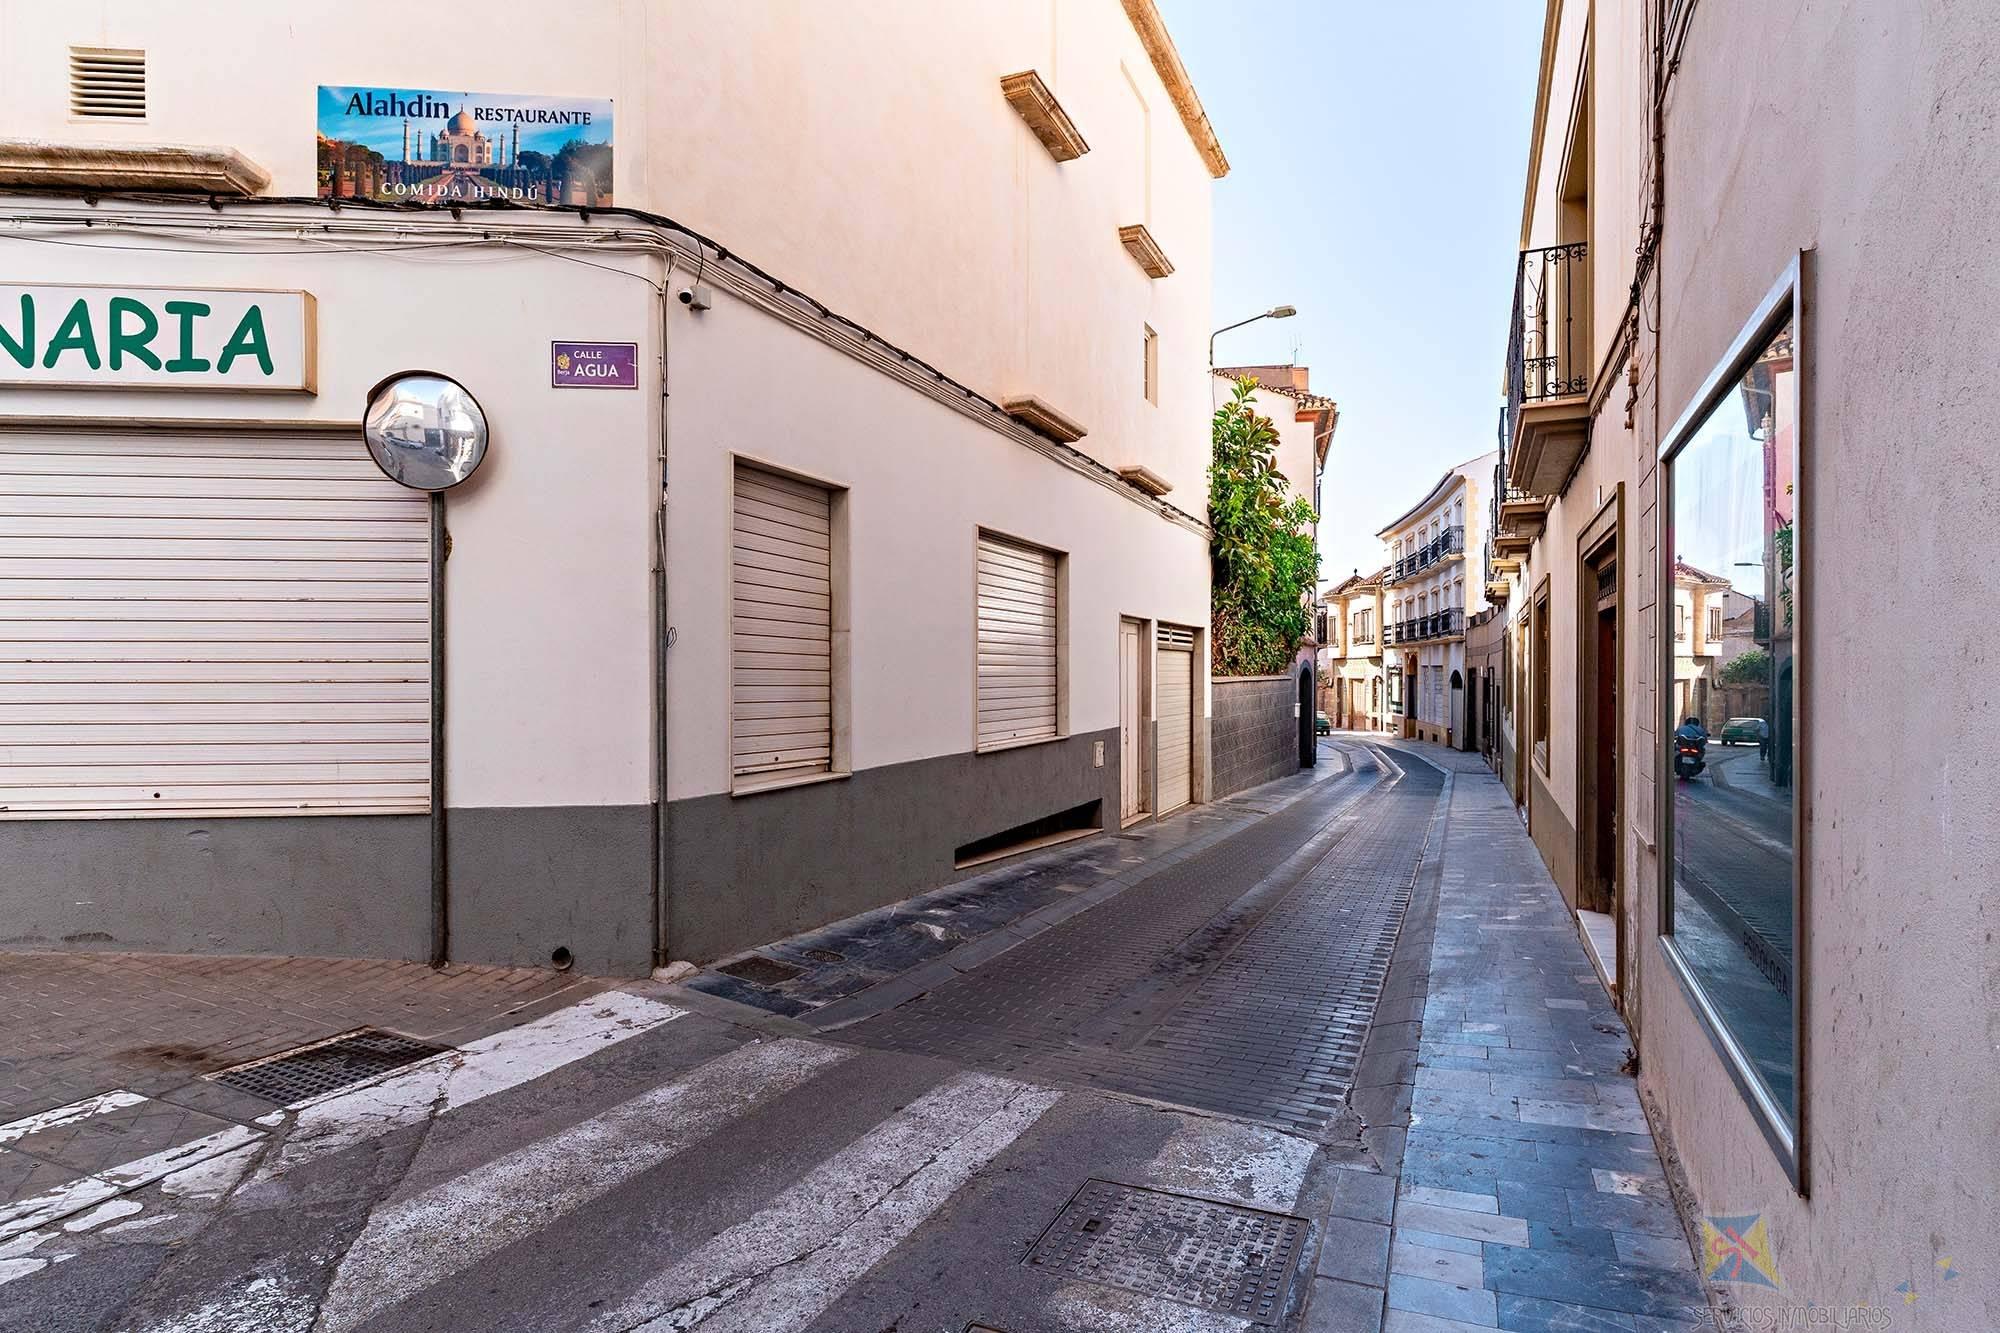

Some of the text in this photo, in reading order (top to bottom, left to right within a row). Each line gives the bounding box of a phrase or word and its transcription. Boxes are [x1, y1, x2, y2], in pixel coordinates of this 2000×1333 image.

[345, 92, 592, 125] Alahdin RESTAURANTE
[381, 183, 539, 201] COMIDA HINDÚ
[573, 350, 603, 359] CALLE
[574, 363, 619, 377] AGUA
